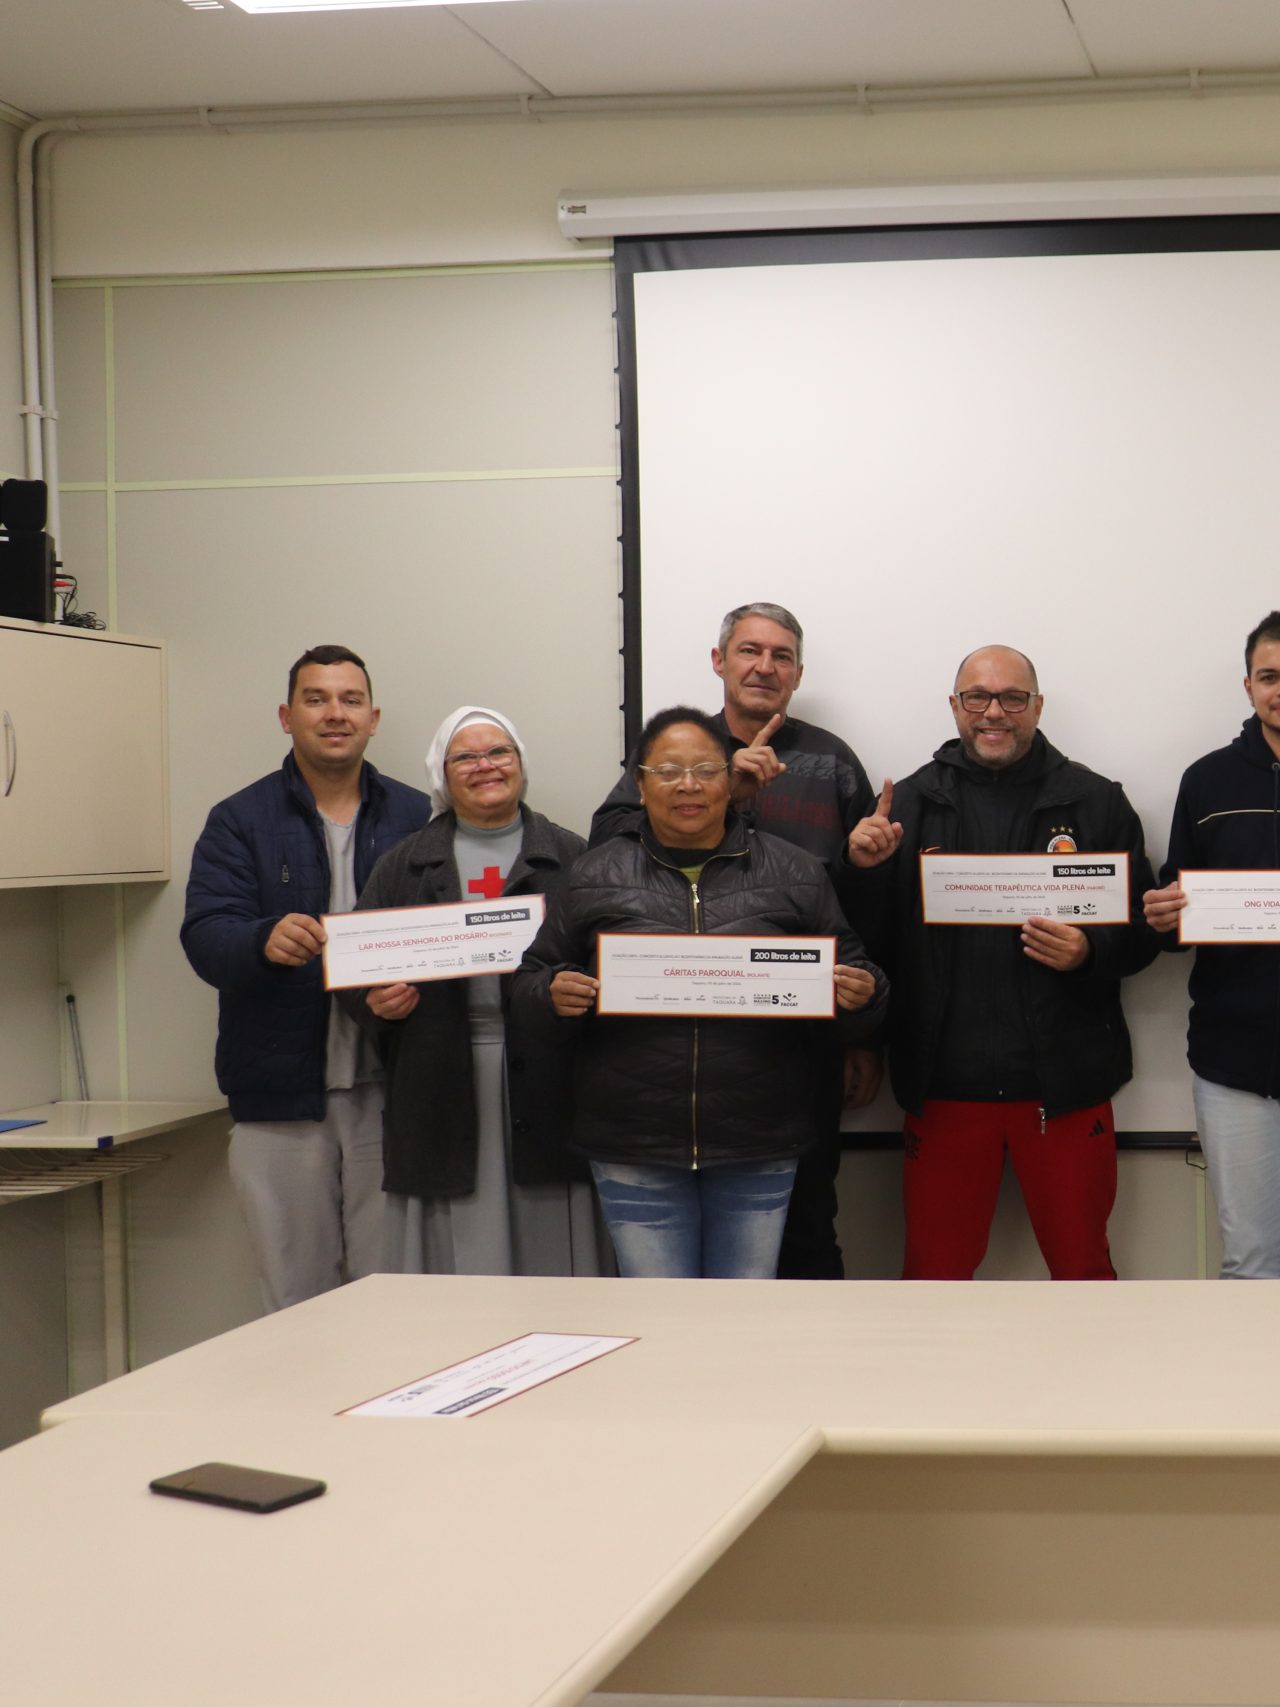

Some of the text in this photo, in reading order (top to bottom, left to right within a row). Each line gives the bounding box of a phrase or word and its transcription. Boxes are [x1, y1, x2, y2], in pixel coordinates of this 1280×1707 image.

[1071, 867, 1086, 875] litros
[1087, 867, 1097, 875] de
[944, 884, 993, 892] COMUNIDADE
[994, 882, 1042, 892] TERAPÊUTICA
[1062, 883, 1085, 891] PLENA
[1244, 900, 1261, 908] ONG
[1263, 900, 1280, 908] VIDA
[1073, 905, 1080, 914] 5
[469, 911, 526, 923] 150 litros de leite
[358, 943, 374, 951] LAR
[374, 941, 402, 949] NOSSA
[402, 936, 440, 947] SENHORA
[441, 934, 454, 942] DO
[454, 930, 488, 941] ROSÁRIO
[488, 952, 496, 962] 5
[754, 951, 817, 961] 200 litros de leite
[663, 967, 697, 977] CÁRITAS
[698, 969, 745, 978] PAROQUIAL
[771, 994, 780, 1005] 5
